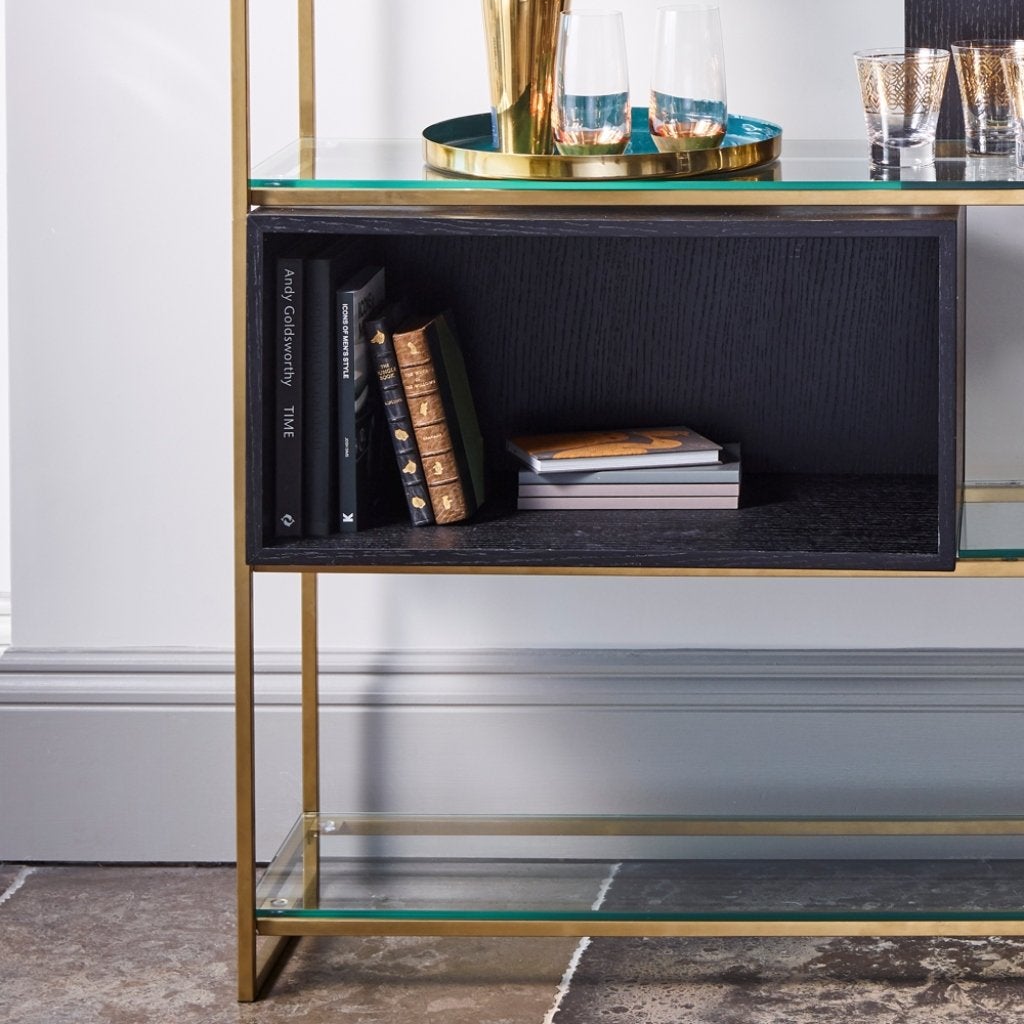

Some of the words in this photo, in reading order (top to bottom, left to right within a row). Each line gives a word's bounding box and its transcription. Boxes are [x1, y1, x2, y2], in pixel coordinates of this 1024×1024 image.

[281, 268, 296, 302] Andy
[281, 305, 296, 388] Goldsworthy
[342, 326, 349, 335] OF
[282, 405, 295, 438] TIME
